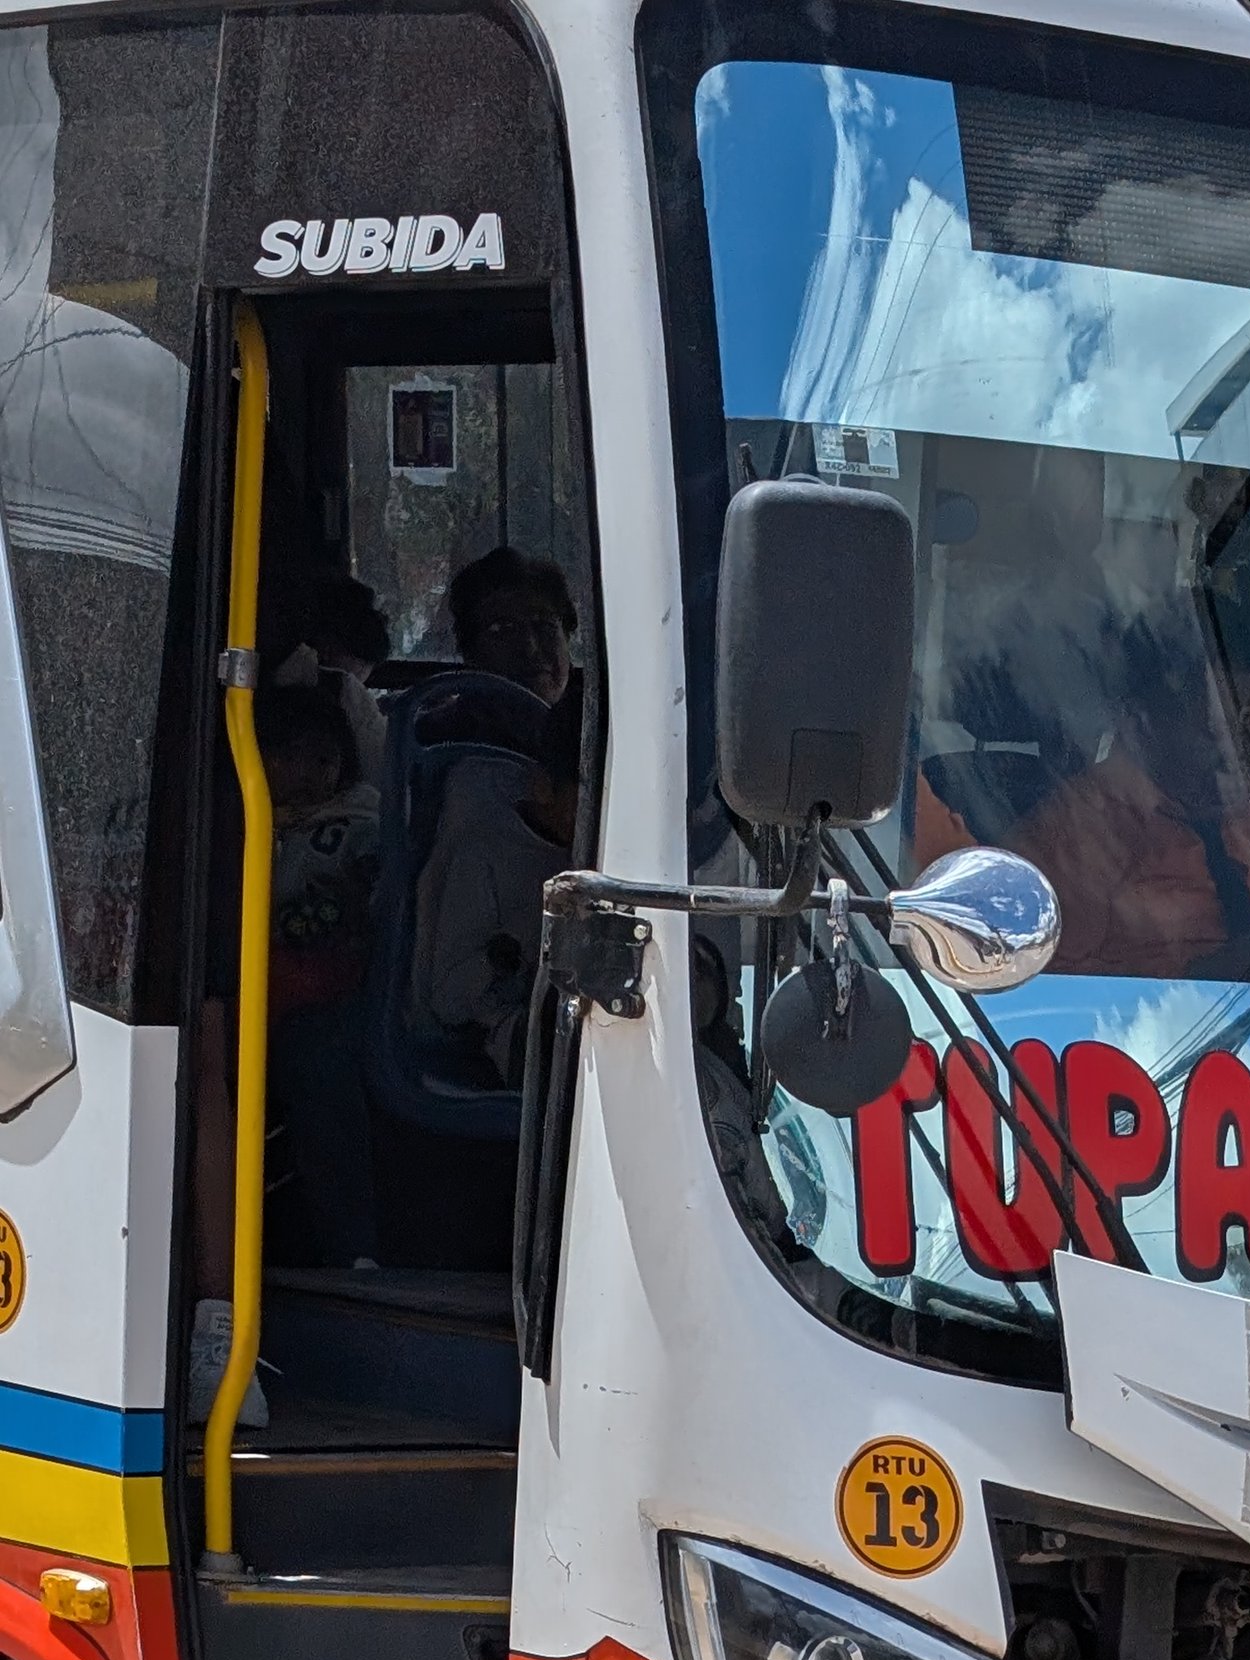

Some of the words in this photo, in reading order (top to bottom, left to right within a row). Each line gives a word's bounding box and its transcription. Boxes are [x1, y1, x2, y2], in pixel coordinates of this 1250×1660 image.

[253, 212, 506, 278] SUBIDA
[872, 1454, 926, 1477] RTU
[864, 1481, 940, 1549] 13
